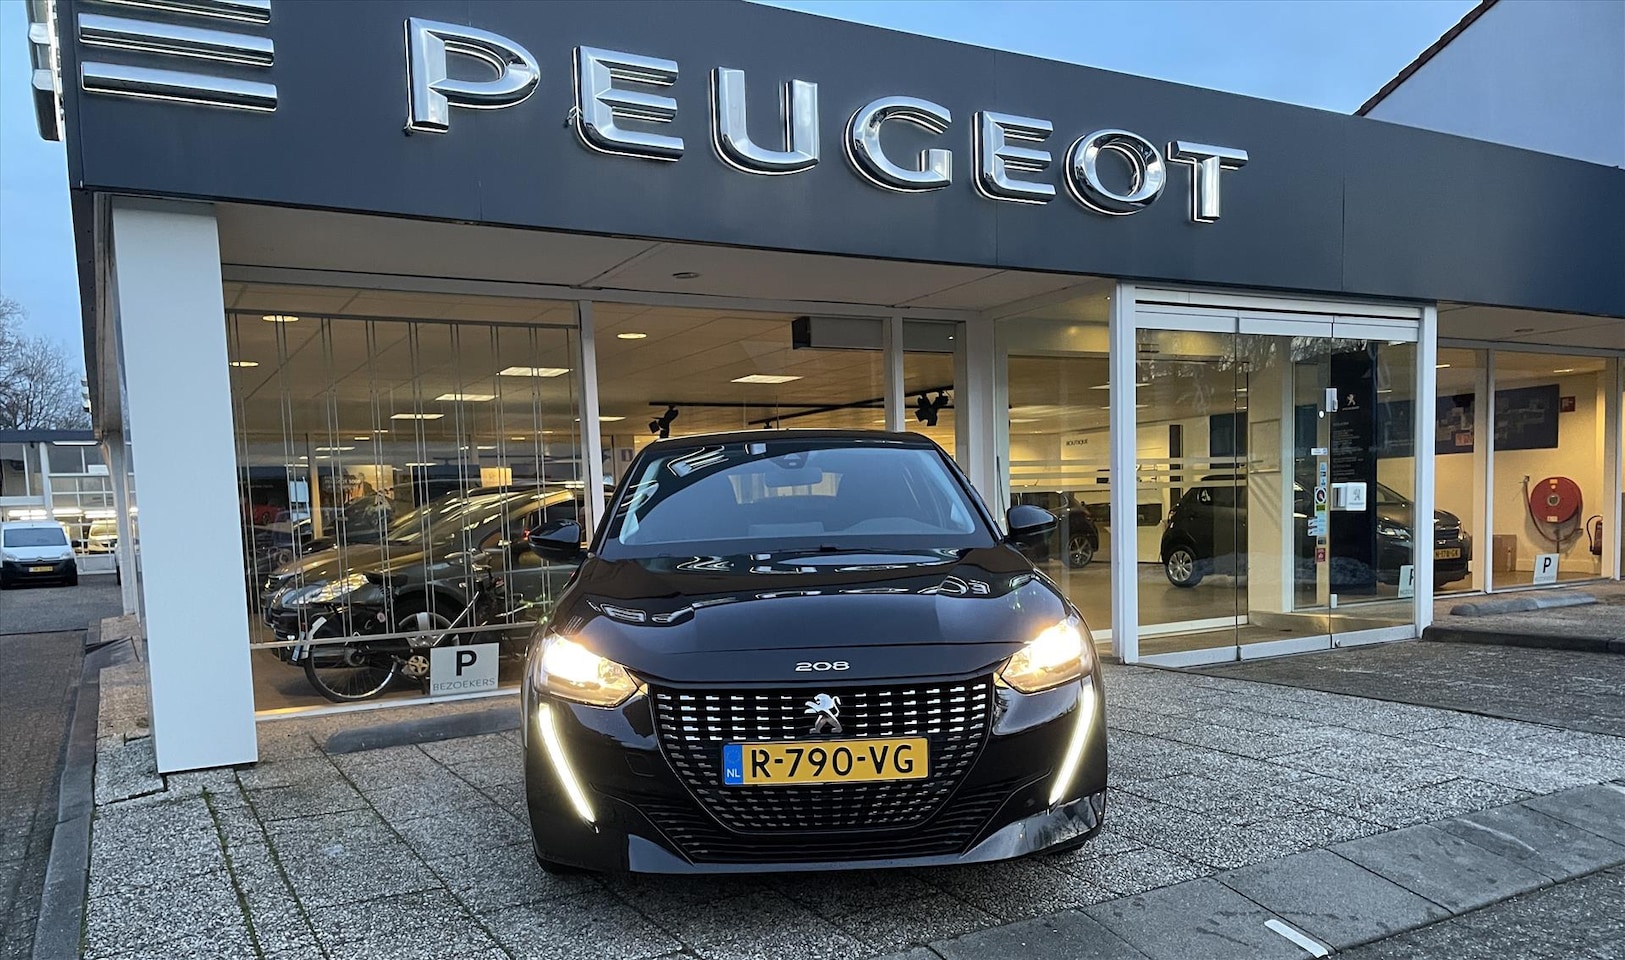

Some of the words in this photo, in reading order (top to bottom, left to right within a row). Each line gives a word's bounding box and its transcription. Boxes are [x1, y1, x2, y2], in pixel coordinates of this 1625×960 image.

[404, 16, 1249, 224] PEUGEOT
[1543, 557, 1552, 573] P
[456, 650, 477, 676] P
[795, 661, 850, 672] 208
[432, 677, 496, 691] BEZOEKERS
[751, 744, 914, 778] R-790-VG
[726, 768, 741, 778] NL
